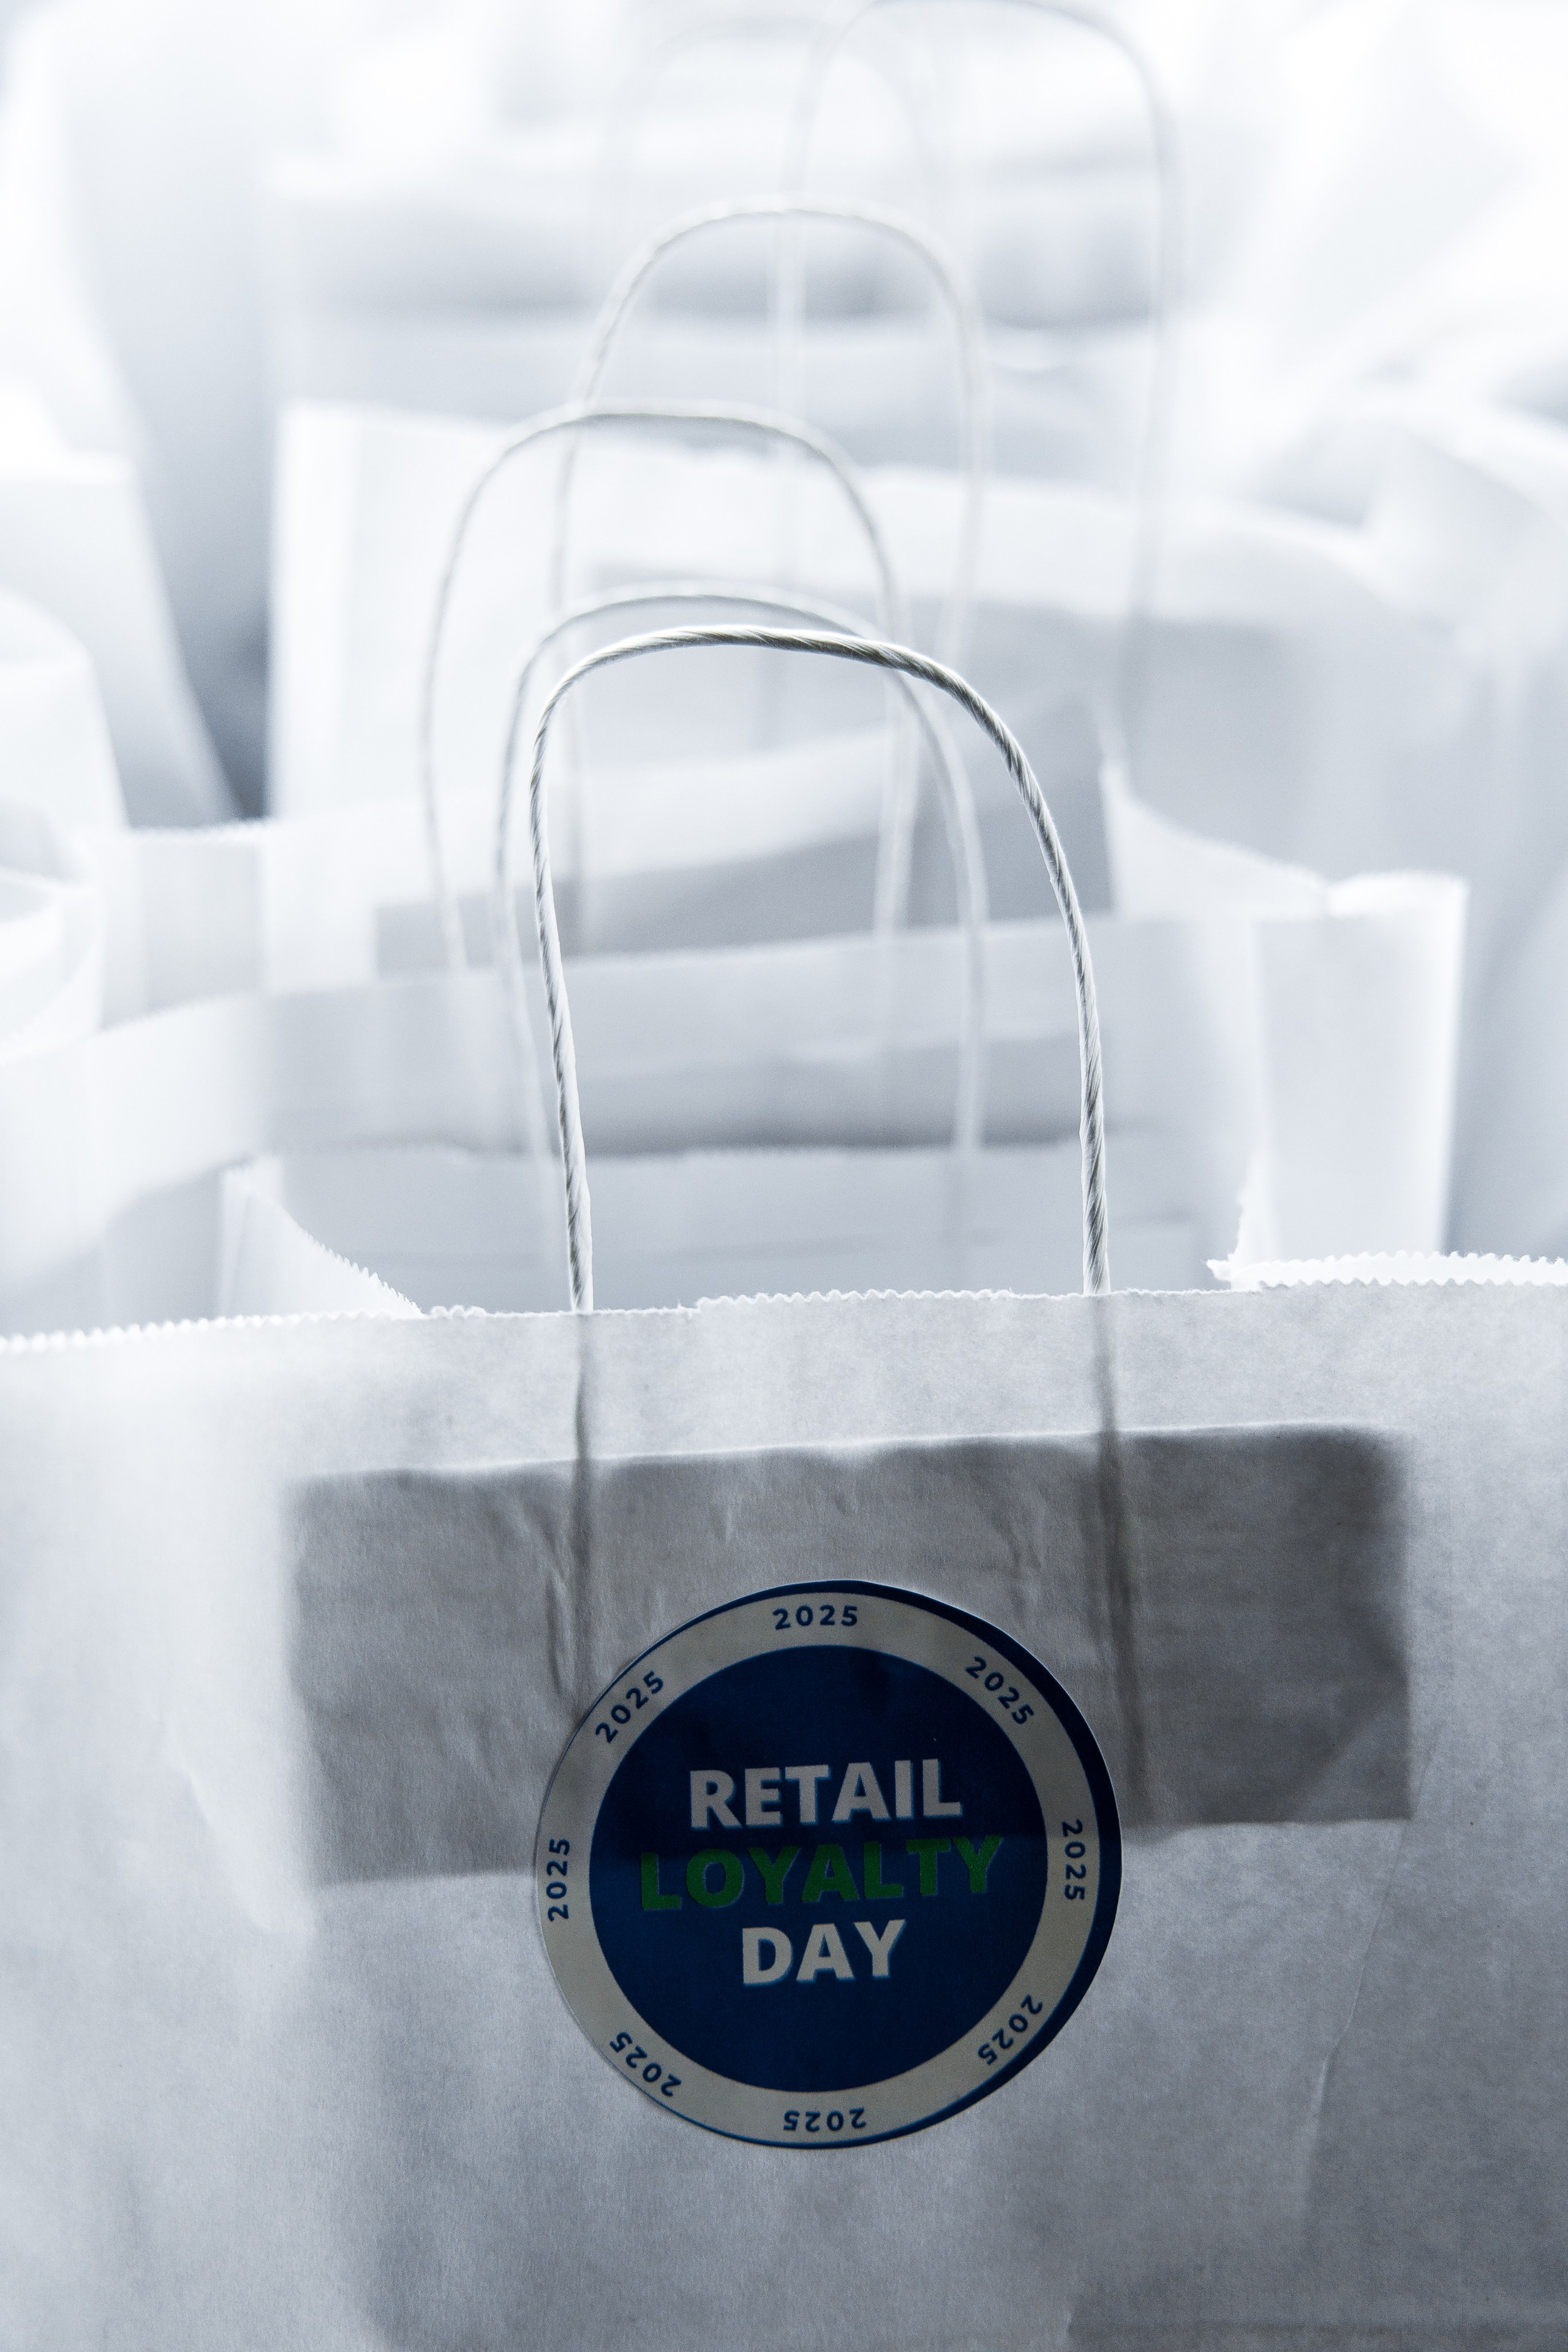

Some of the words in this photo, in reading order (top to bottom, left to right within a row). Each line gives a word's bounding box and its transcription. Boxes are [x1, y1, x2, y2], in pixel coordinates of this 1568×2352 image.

[773, 1604, 858, 1630] 2025
[595, 1671, 665, 1743] 2025
[965, 1657, 1035, 1725] 2025
[690, 1758, 962, 1830] RETAIL
[548, 1838, 570, 1922] 2025
[640, 1834, 1002, 1910] LOYALTY
[1061, 1819, 1086, 1902] 2025
[742, 1920, 906, 1986] DAY
[609, 2031, 682, 2097] 2025
[977, 1994, 1042, 2065] 2025
[783, 2107, 867, 2133] 2025
